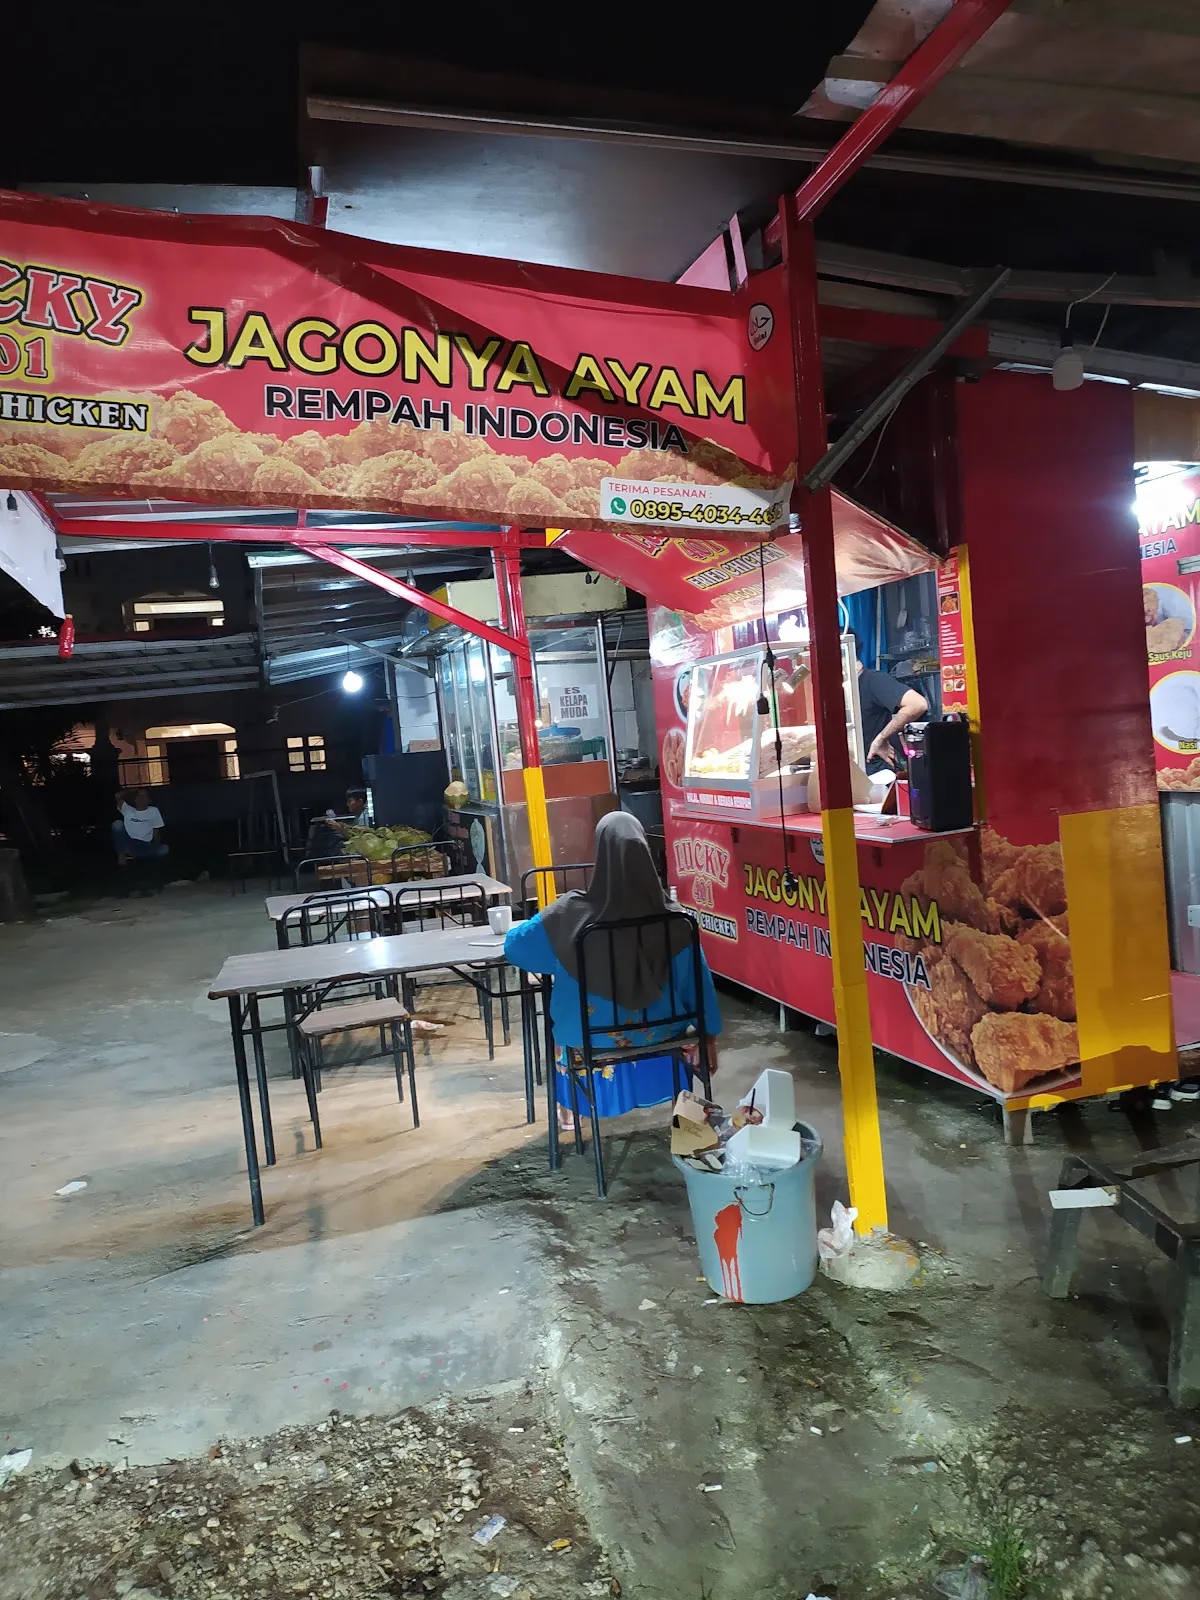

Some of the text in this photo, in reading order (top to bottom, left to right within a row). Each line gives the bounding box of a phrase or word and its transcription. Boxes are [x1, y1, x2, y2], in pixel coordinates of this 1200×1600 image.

[185, 306, 746, 424] JAGONYA AYAM
[264, 384, 690, 455] REMPAH INDONESIA
[608, 482, 650, 495] TERIMA
[653, 486, 707, 499] PESANAN
[685, 567, 731, 590] FRIED
[719, 542, 791, 577] CHICKEN
[1148, 649, 1192, 663] Saus Keju
[559, 694, 588, 707] KELAPA
[564, 686, 581, 695] ES
[561, 706, 588, 719] MUDA
[1179, 740, 1198, 750] Nasi
[674, 839, 730, 886] LUCKY
[743, 863, 943, 944] JAGONY AYAM
[700, 911, 738, 940] CHICKEN
[745, 906, 932, 991] REMPAH INNESIA
